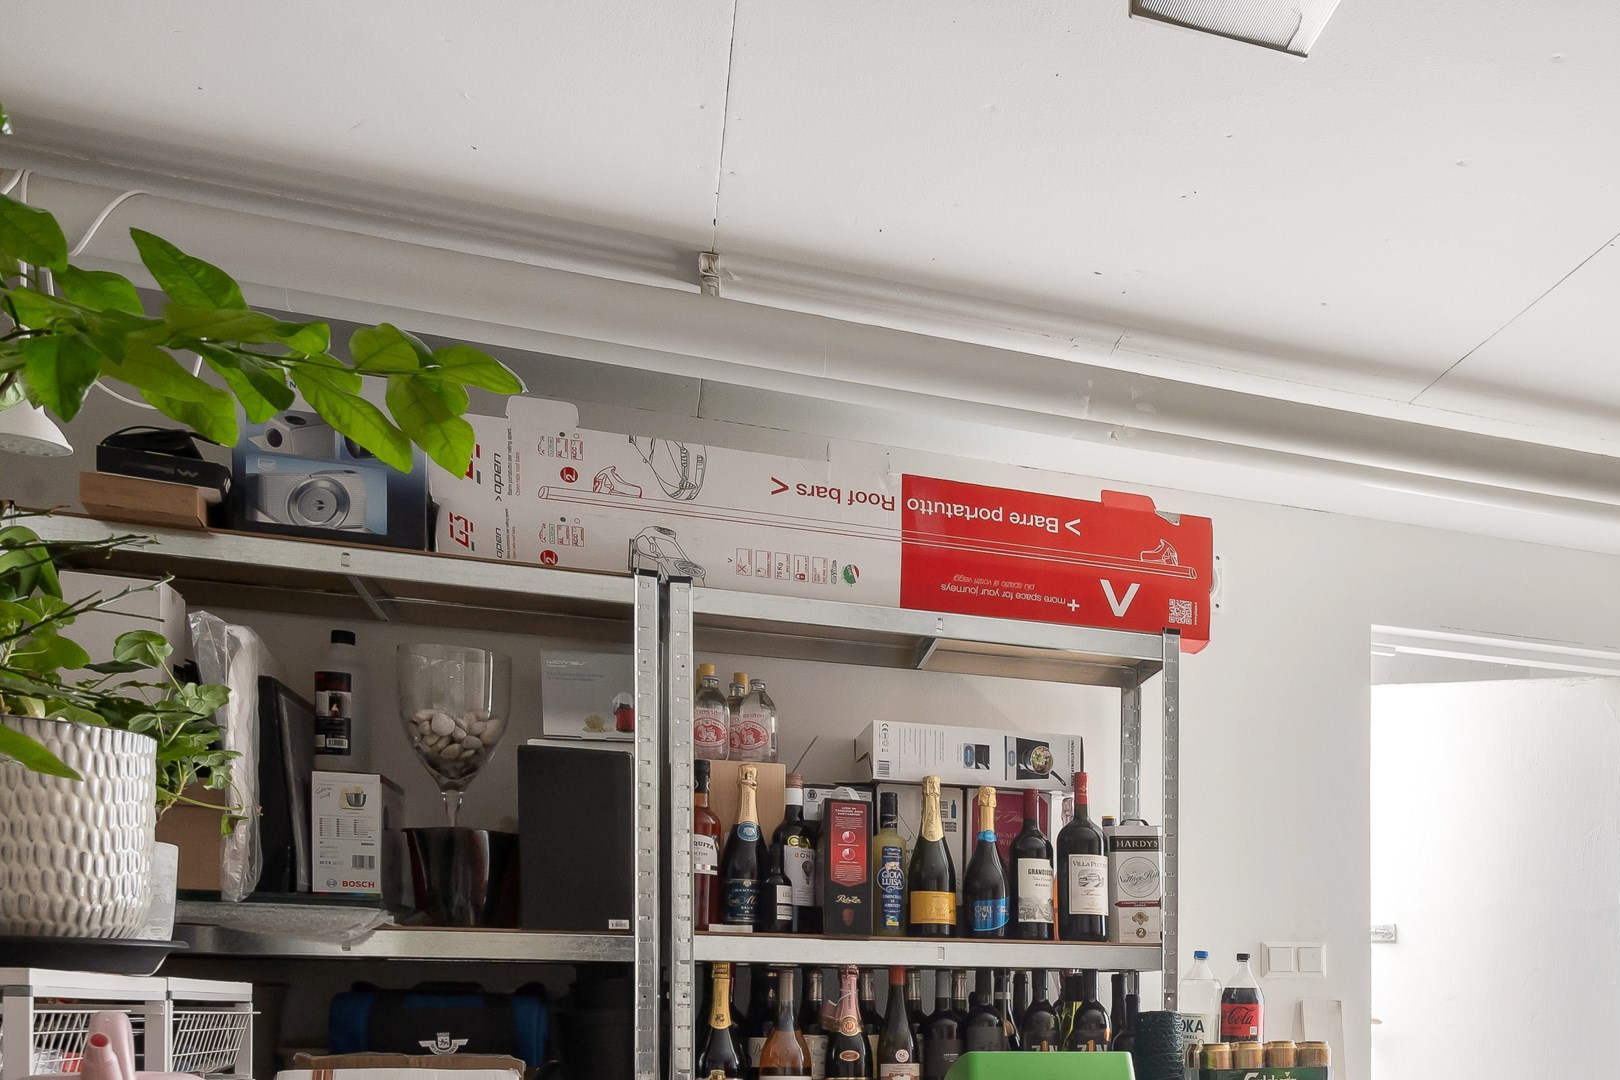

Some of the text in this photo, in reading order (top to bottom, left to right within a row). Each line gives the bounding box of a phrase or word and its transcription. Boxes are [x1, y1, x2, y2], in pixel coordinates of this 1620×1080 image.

[796, 483, 895, 511] Roof bars
[907, 498, 1059, 533] Barre portatutto
[940, 583, 1066, 605] more space for your journeys
[1116, 840, 1158, 848] HARDYS
[1228, 1006, 1256, 1025] Cola
